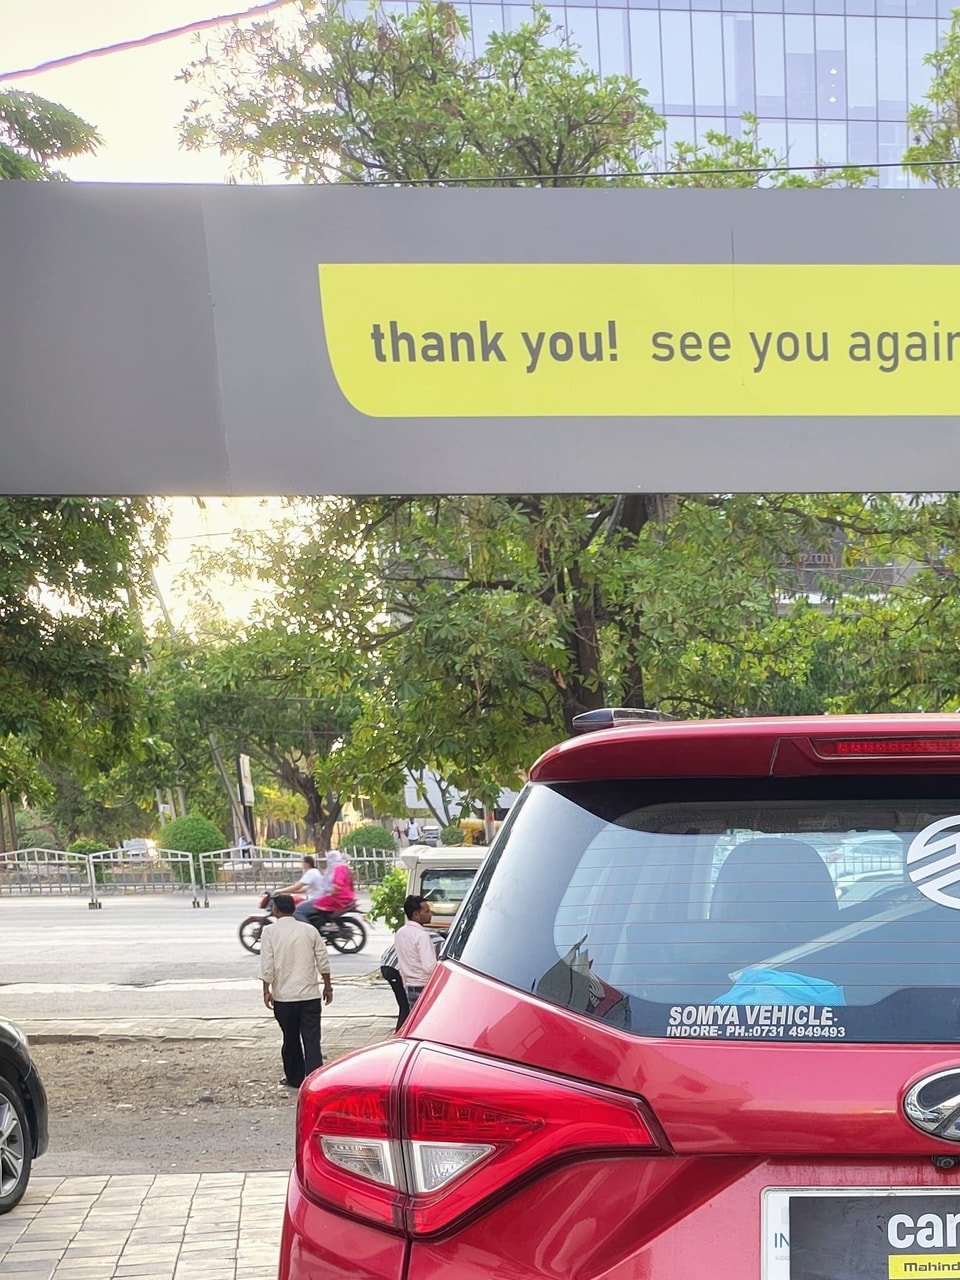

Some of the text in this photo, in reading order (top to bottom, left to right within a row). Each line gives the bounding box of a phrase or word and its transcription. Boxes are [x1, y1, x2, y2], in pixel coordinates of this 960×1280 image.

[371, 321, 508, 364] thank
[521, 321, 619, 374] you!
[651, 329, 731, 364] see
[749, 329, 829, 374] you
[668, 1006, 739, 1025] SOMYA
[788, 1026, 846, 1038] 4949493
